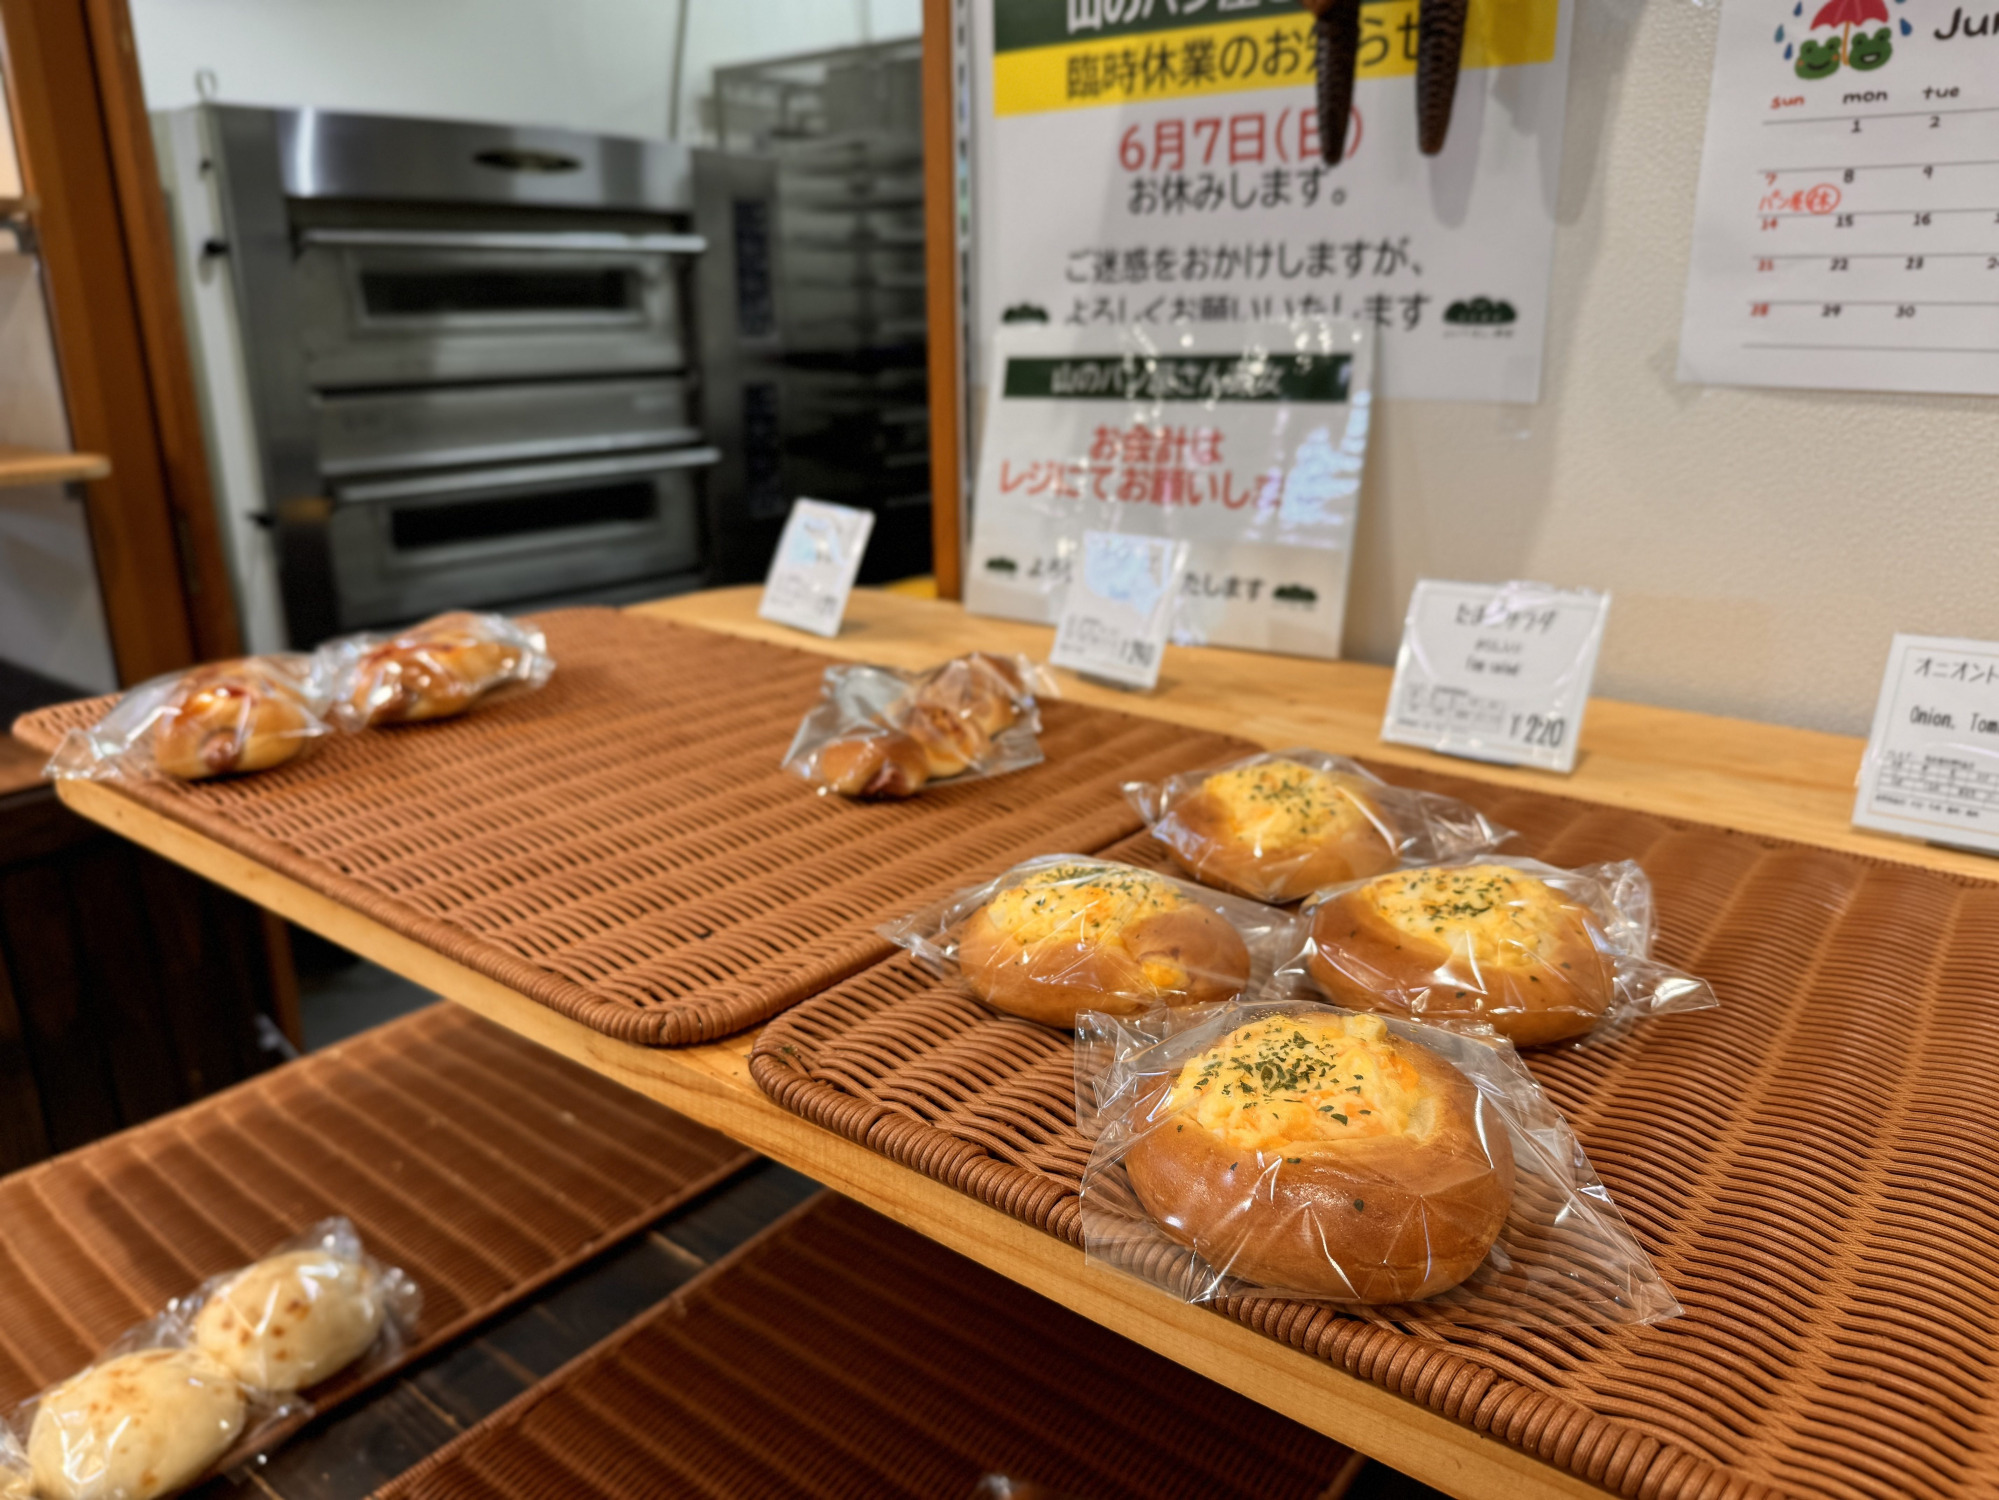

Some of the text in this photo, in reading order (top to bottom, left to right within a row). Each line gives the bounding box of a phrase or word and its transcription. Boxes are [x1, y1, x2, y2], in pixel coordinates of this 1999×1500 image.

[1770, 86, 1960, 109] sun mon tue
[1850, 115, 1940, 133] 1 2
[1764, 165, 1934, 186] 7 8 9
[1127, 166, 1346, 216] お休みします。
[1761, 213, 1931, 231] 14 15 16
[1065, 236, 1424, 284] ご迷惑をおかけしますが、
[1757, 258, 1774, 272] 21
[1830, 257, 1849, 272] 22
[1905, 256, 1924, 270] 23
[1750, 304, 1916, 318] 28 29 30
[1970, 712, 1999, 734] Tom
